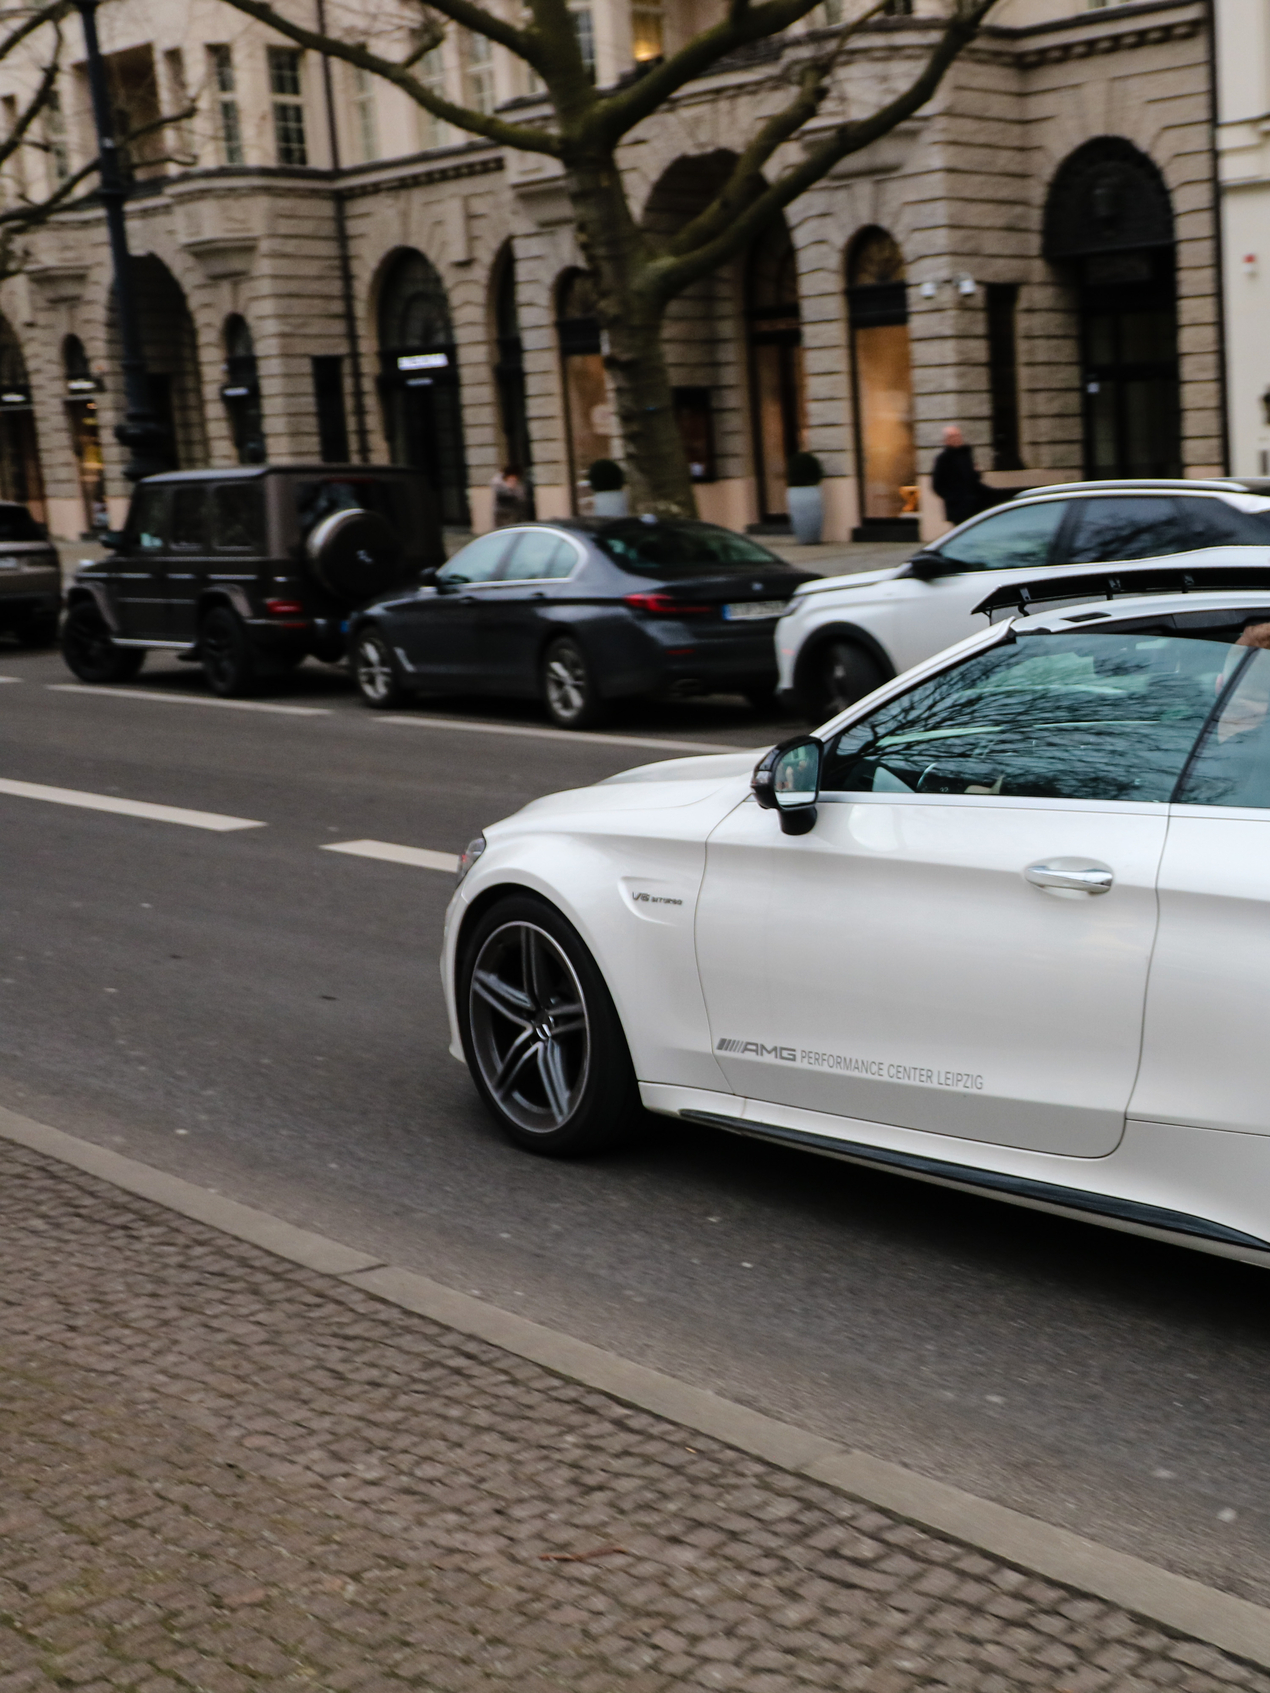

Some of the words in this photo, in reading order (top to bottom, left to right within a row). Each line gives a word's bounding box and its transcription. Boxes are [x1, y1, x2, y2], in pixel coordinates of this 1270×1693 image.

[741, 1041, 797, 1062] AMG
[800, 1050, 884, 1077] PERFORMANCE
[887, 1064, 933, 1084] CENTER
[937, 1071, 984, 1090] LEIPZIG
